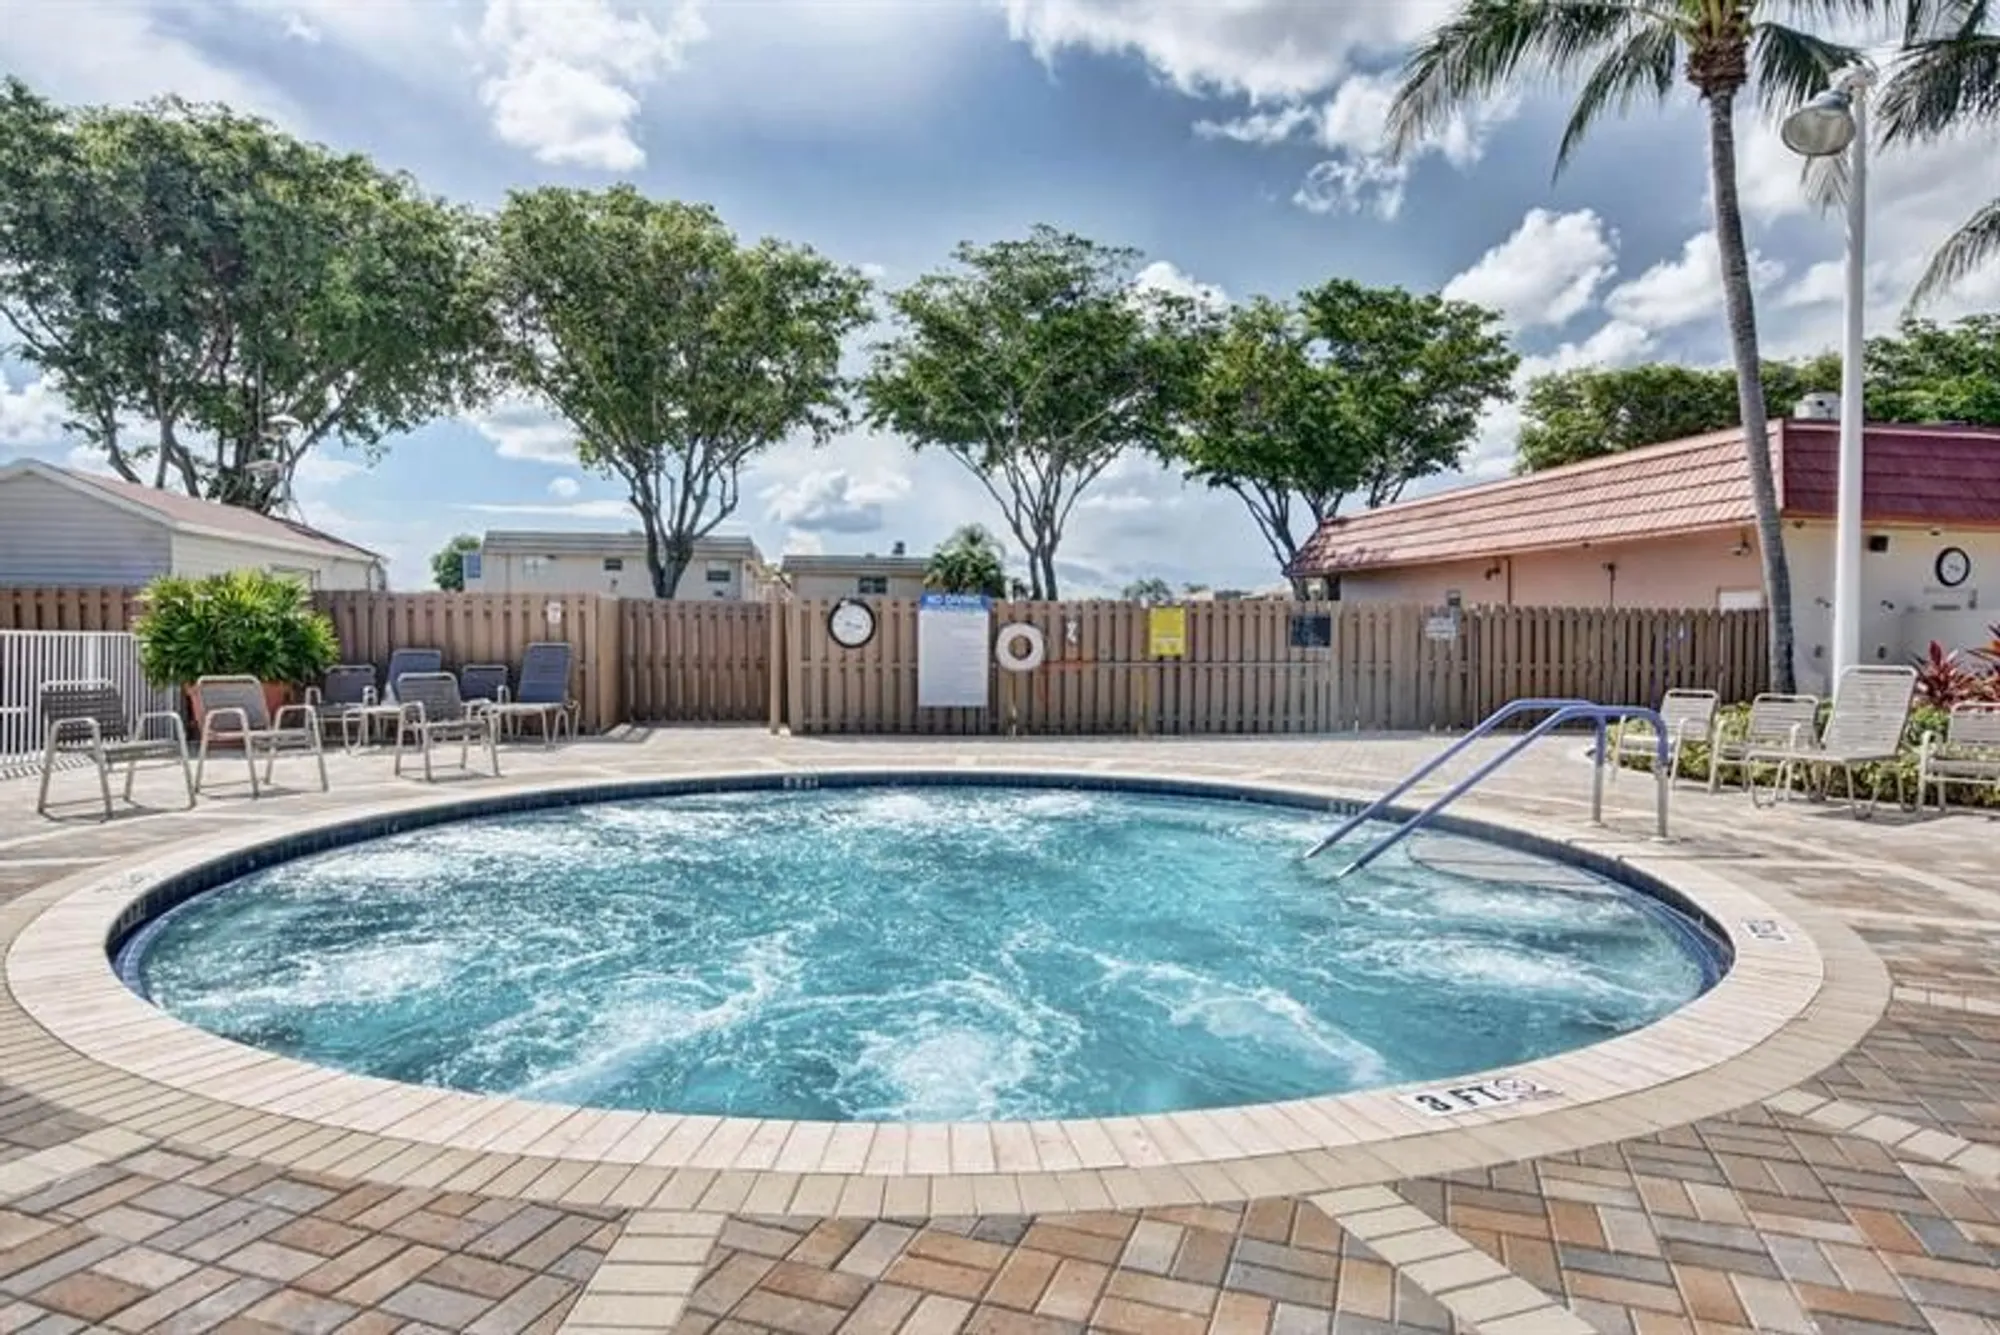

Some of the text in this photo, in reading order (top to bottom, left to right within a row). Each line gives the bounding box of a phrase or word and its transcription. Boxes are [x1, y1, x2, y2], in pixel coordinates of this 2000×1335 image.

[926, 594, 942, 604] NO
[1415, 1085, 1504, 1112] 3 FT
